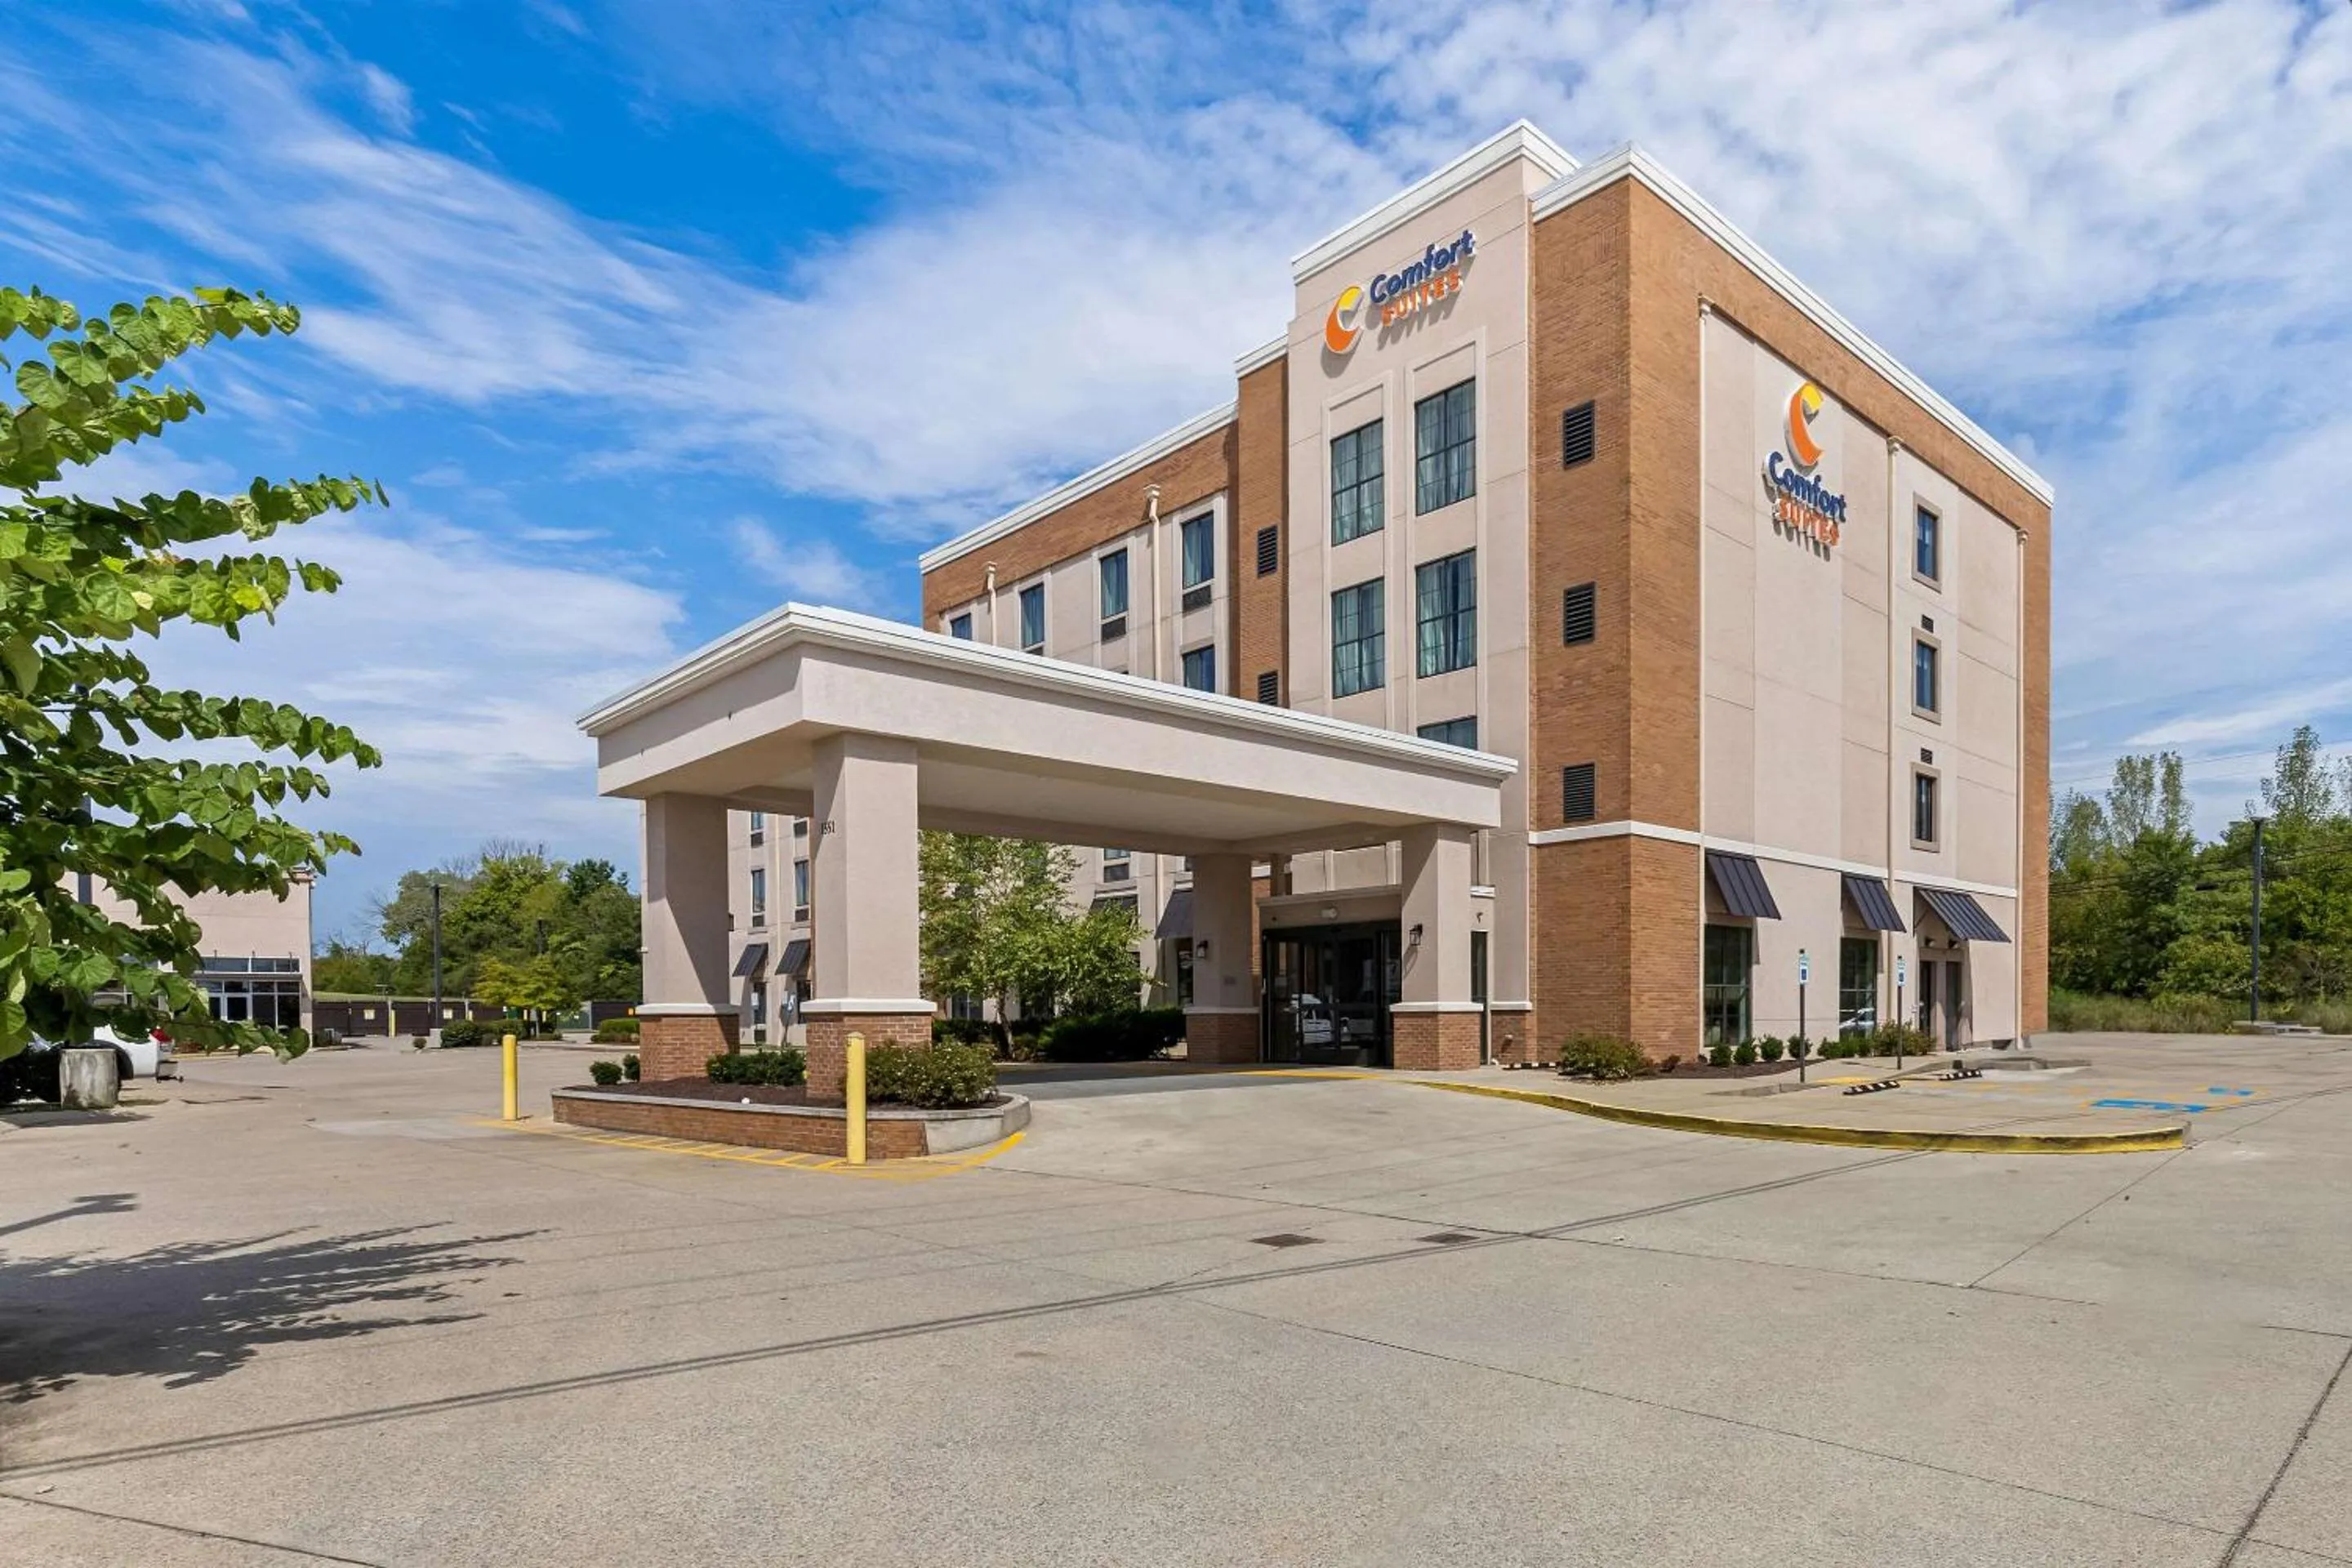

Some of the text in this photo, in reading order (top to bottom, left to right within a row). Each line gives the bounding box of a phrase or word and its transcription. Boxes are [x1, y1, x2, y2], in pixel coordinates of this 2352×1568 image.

[1370, 229, 1476, 303] Comfort
[1381, 265, 1464, 327] SUITES
[1766, 451, 1846, 523] Comfort
[1776, 497, 1841, 546] SUITES
